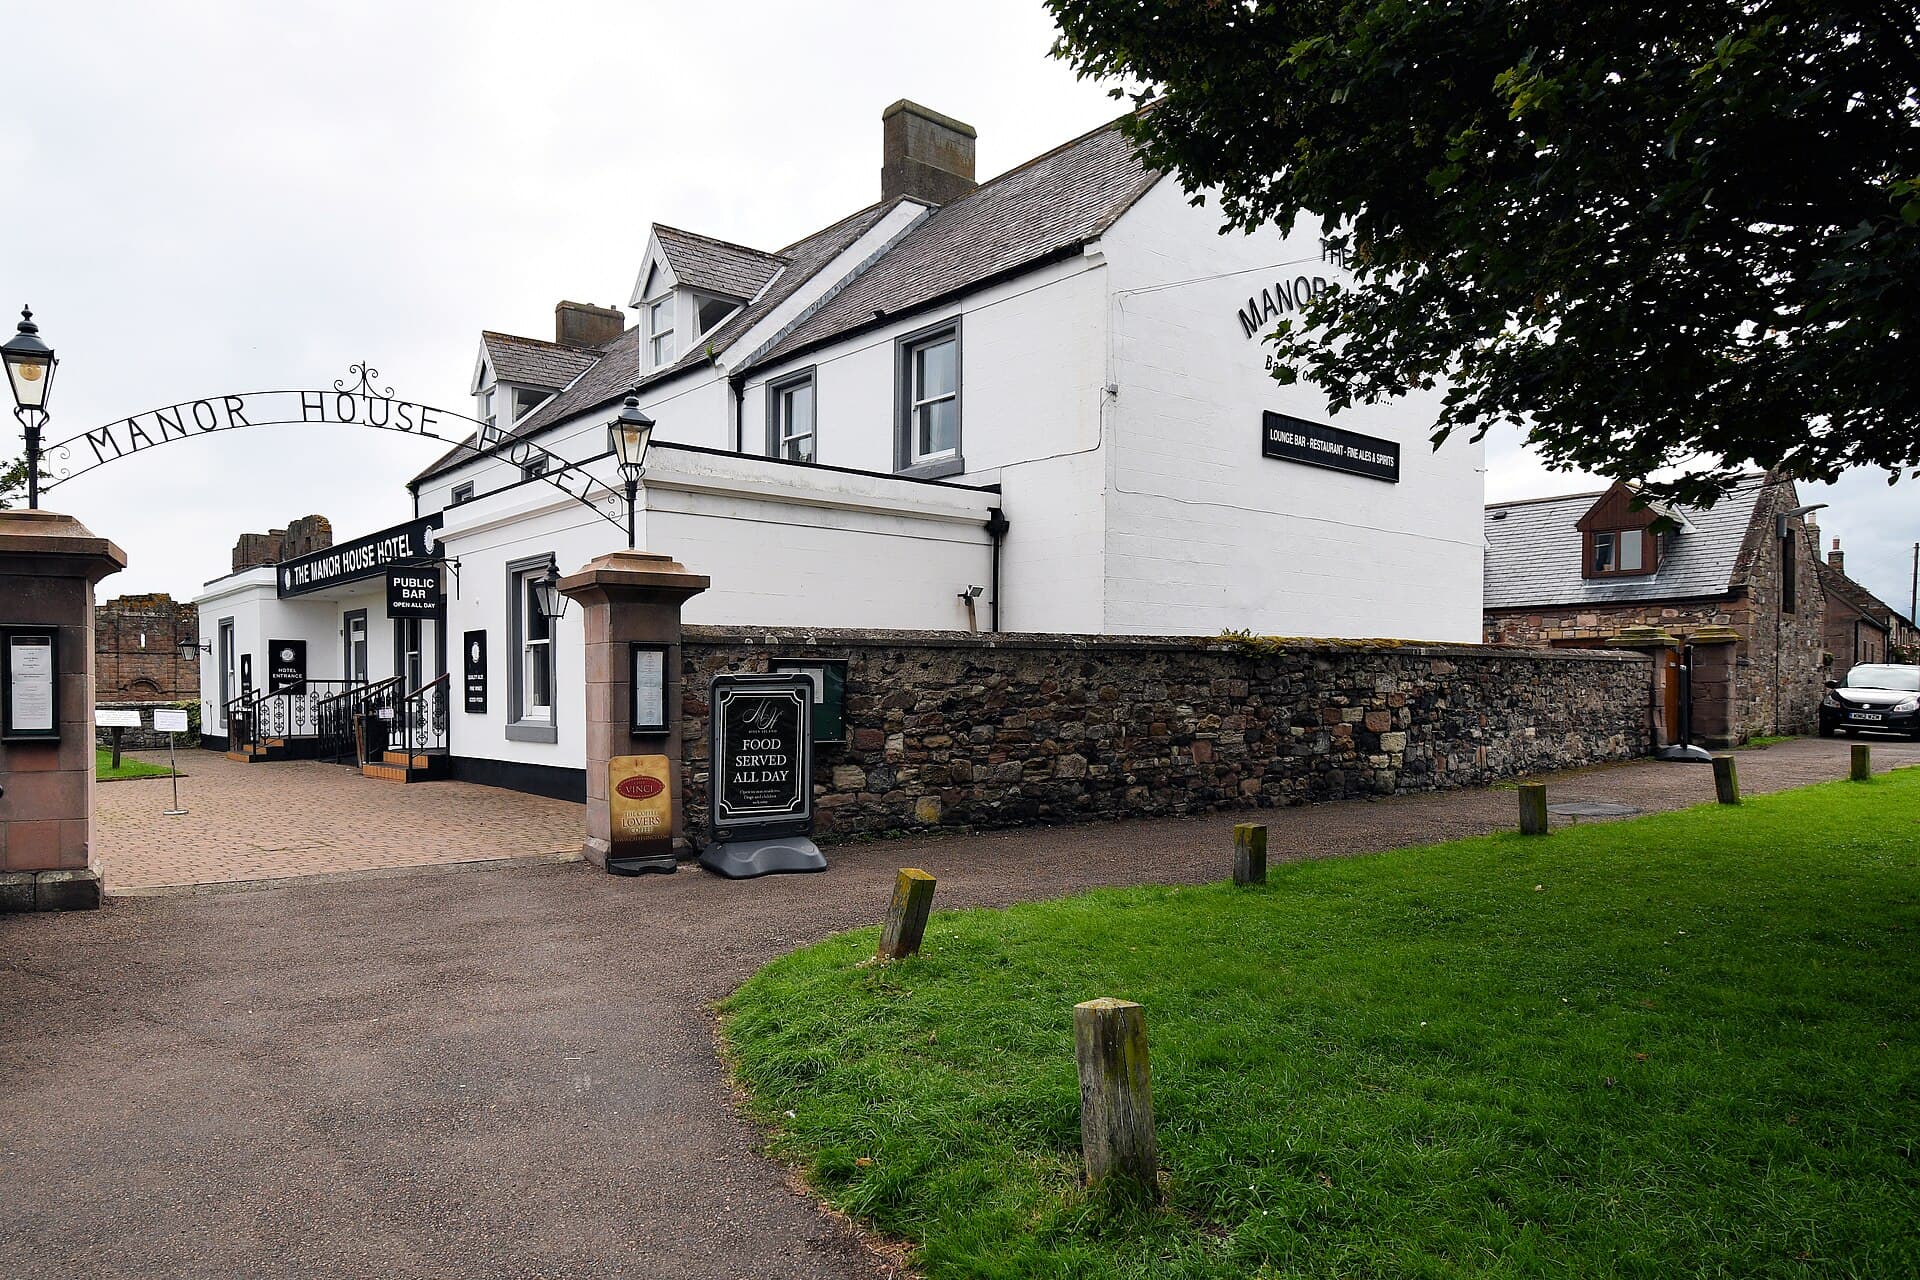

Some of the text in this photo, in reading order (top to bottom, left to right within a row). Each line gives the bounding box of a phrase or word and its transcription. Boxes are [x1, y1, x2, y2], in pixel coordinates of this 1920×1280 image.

[85, 395, 250, 464] MANOR
[300, 390, 442, 438] HOUSE
[1269, 428, 1294, 445] LOUNGE
[1294, 435, 1306, 447] BAR
[1309, 438, 1344, 456] RESTAURANT
[1347, 446, 1359, 459] FINE
[1358, 451, 1372, 462] ALES
[1376, 455, 1395, 467] SPIRITS
[293, 533, 414, 586] THE MANOR HOUSE HOTEL
[393, 577, 435, 588] PUBLIC
[402, 588, 426, 599] BAR
[742, 738, 781, 751] FOOD
[735, 754, 787, 767] SERVED
[733, 770, 790, 783] ALL DAY
[625, 784, 653, 793] VINCI
[621, 816, 662, 828] LOVERS
